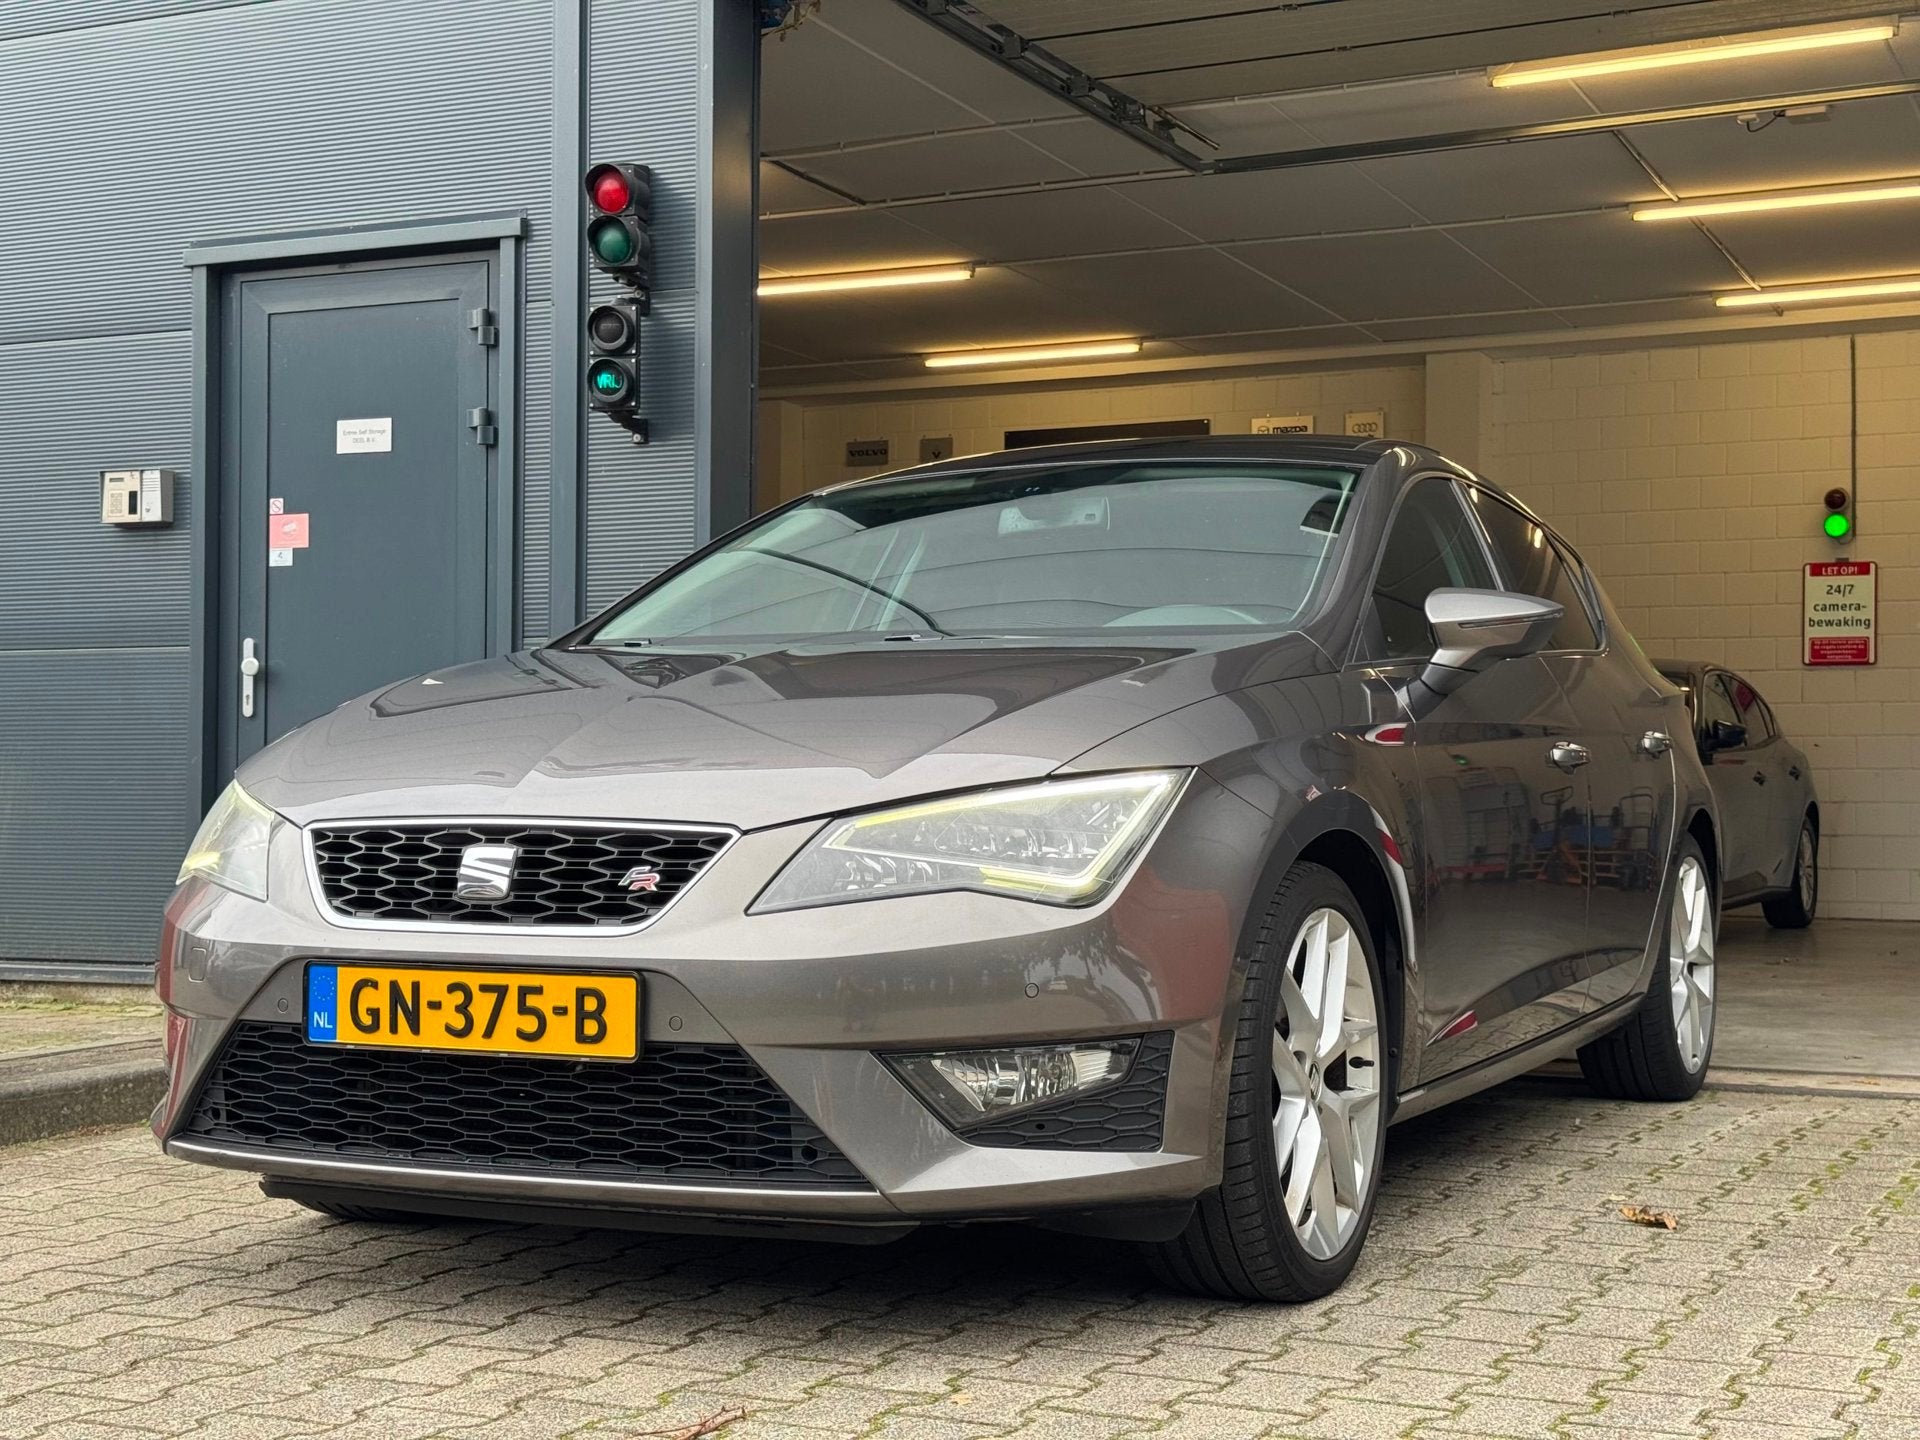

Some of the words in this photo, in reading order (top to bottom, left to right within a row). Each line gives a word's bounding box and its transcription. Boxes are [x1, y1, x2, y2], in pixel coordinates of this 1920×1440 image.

[848, 448, 887, 458] VOLVO
[1822, 567, 1838, 575] LET
[1840, 566, 1858, 575] OP!
[1826, 584, 1854, 597] 24/7
[1813, 603, 1867, 612] camera-
[1808, 617, 1871, 629] bewaking
[349, 977, 608, 1045] GN-375-B
[313, 1010, 333, 1029] NL
